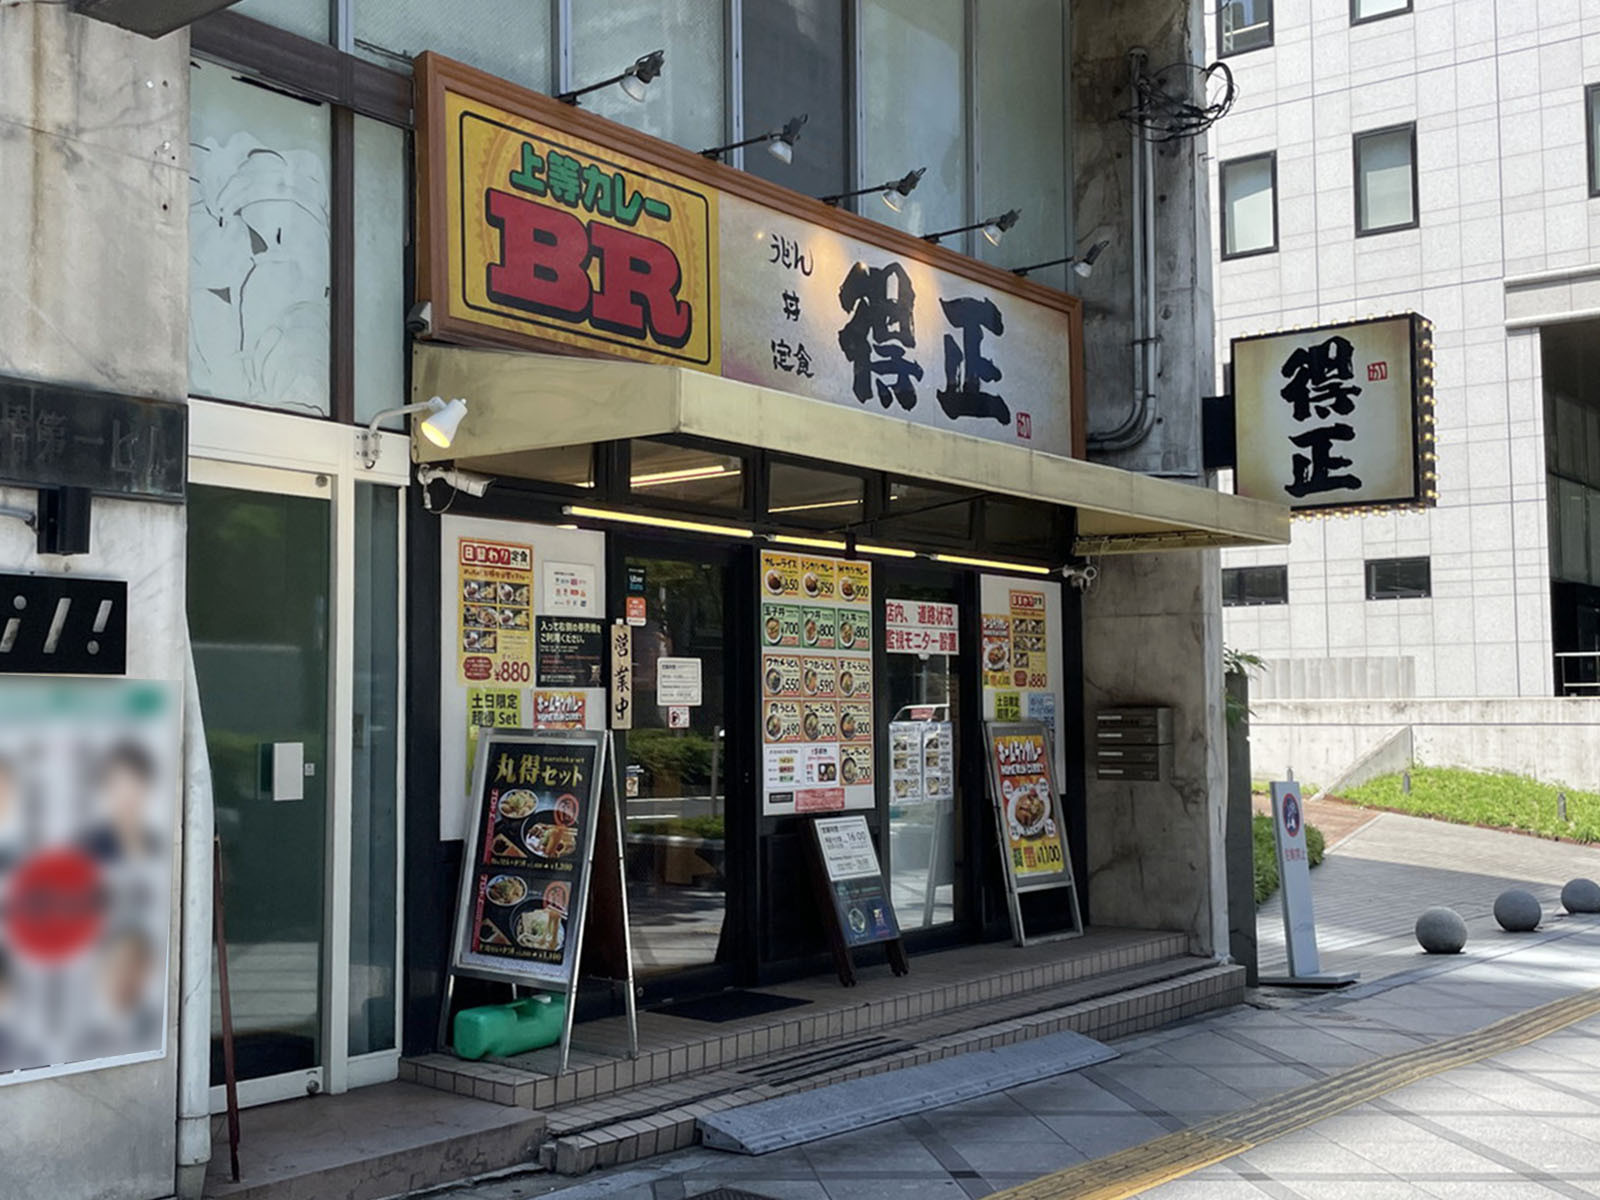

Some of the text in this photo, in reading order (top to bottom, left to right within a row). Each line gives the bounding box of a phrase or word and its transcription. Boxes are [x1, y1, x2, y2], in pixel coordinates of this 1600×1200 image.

[509, 140, 671, 226] 上等カレー
[485, 187, 692, 349] BR
[769, 234, 814, 277] うどん
[771, 338, 815, 379] 定食
[838, 261, 1012, 427] 得正
[1280, 335, 1362, 498] 得正
[471, 694, 518, 710] 土日限定
[614, 633, 630, 720] 営業中
[498, 712, 517, 725] Set
[495, 753, 583, 787] 丸得セット
